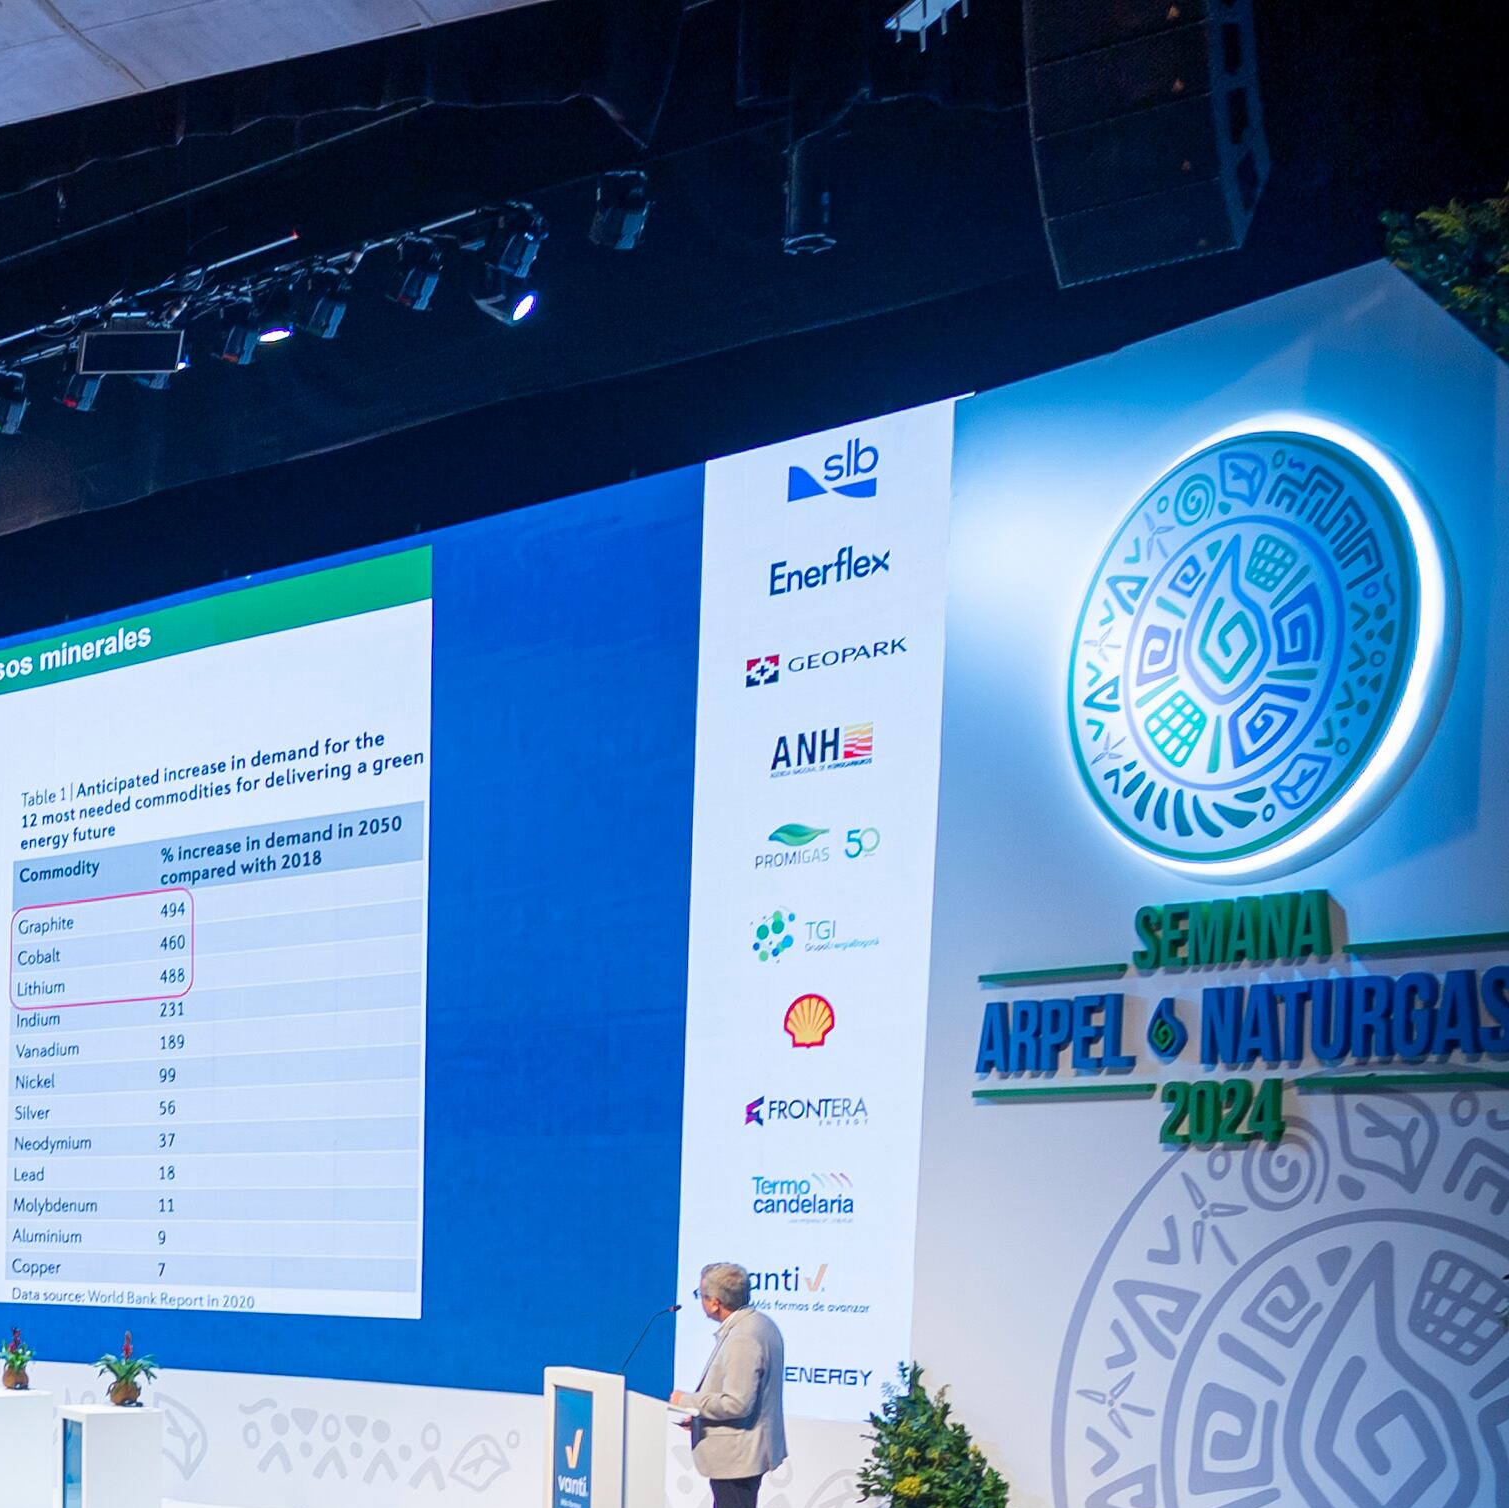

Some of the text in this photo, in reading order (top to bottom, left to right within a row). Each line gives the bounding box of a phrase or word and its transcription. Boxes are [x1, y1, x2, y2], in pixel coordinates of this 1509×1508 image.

[824, 437, 879, 483] slb
[770, 545, 890, 596] Enerflex
[39, 624, 152, 671] minerales
[788, 636, 907, 673] GEOPARK
[771, 727, 840, 770] ANH
[21, 789, 56, 808] Table
[77, 768, 159, 799] Anticipated
[163, 759, 226, 783] increase
[231, 756, 246, 770] in
[250, 741, 319, 768] demand
[324, 738, 350, 755] for
[356, 732, 384, 750] the
[21, 750, 424, 828] 12 most needed commodities for delivering a green
[20, 823, 116, 852] energy future
[161, 815, 402, 863] % increase in demand in 2050
[755, 846, 830, 870] PROMIGAS
[19, 859, 100, 883] Commodity
[160, 850, 322, 886] compared with 2018
[160, 902, 185, 918] 494
[18, 915, 74, 935] Graphite
[806, 921, 836, 940] TGI
[1132, 889, 1334, 971] SEMANA
[160, 935, 185, 951] 460
[18, 947, 60, 966] Cobalt
[160, 968, 185, 984] 488
[17, 980, 65, 997] Lithium
[159, 1002, 185, 1017] 231
[16, 1011, 60, 1028] Indium
[160, 1034, 185, 1050] 189
[975, 993, 1136, 1075] ARPEL
[15, 1042, 79, 1059] Vanadium
[15, 1074, 55, 1089] Nickel
[159, 1068, 176, 1084] 99
[14, 1105, 50, 1121] Silver
[159, 1101, 175, 1116] 56
[768, 1097, 868, 1120] FRONTERA
[1161, 1078, 1285, 1145] 2024
[14, 1135, 92, 1154] Neodymium
[159, 1133, 175, 1148] 37
[14, 1167, 45, 1182] Lead
[159, 1166, 175, 1181] 18
[752, 1176, 811, 1196] Termo
[13, 1198, 98, 1215] Molybdenum
[158, 1199, 175, 1213] 11
[753, 1195, 854, 1214] candelaria
[13, 1228, 82, 1244] Aluminium
[158, 1231, 166, 1246] 9
[12, 1260, 60, 1278] Copper
[158, 1263, 166, 1277] 7
[748, 1265, 799, 1292] anti
[774, 1301, 809, 1312] formas
[812, 1302, 824, 1312] de
[785, 1366, 872, 1386] ENERGY
[558, 1475, 588, 1497] vanti
